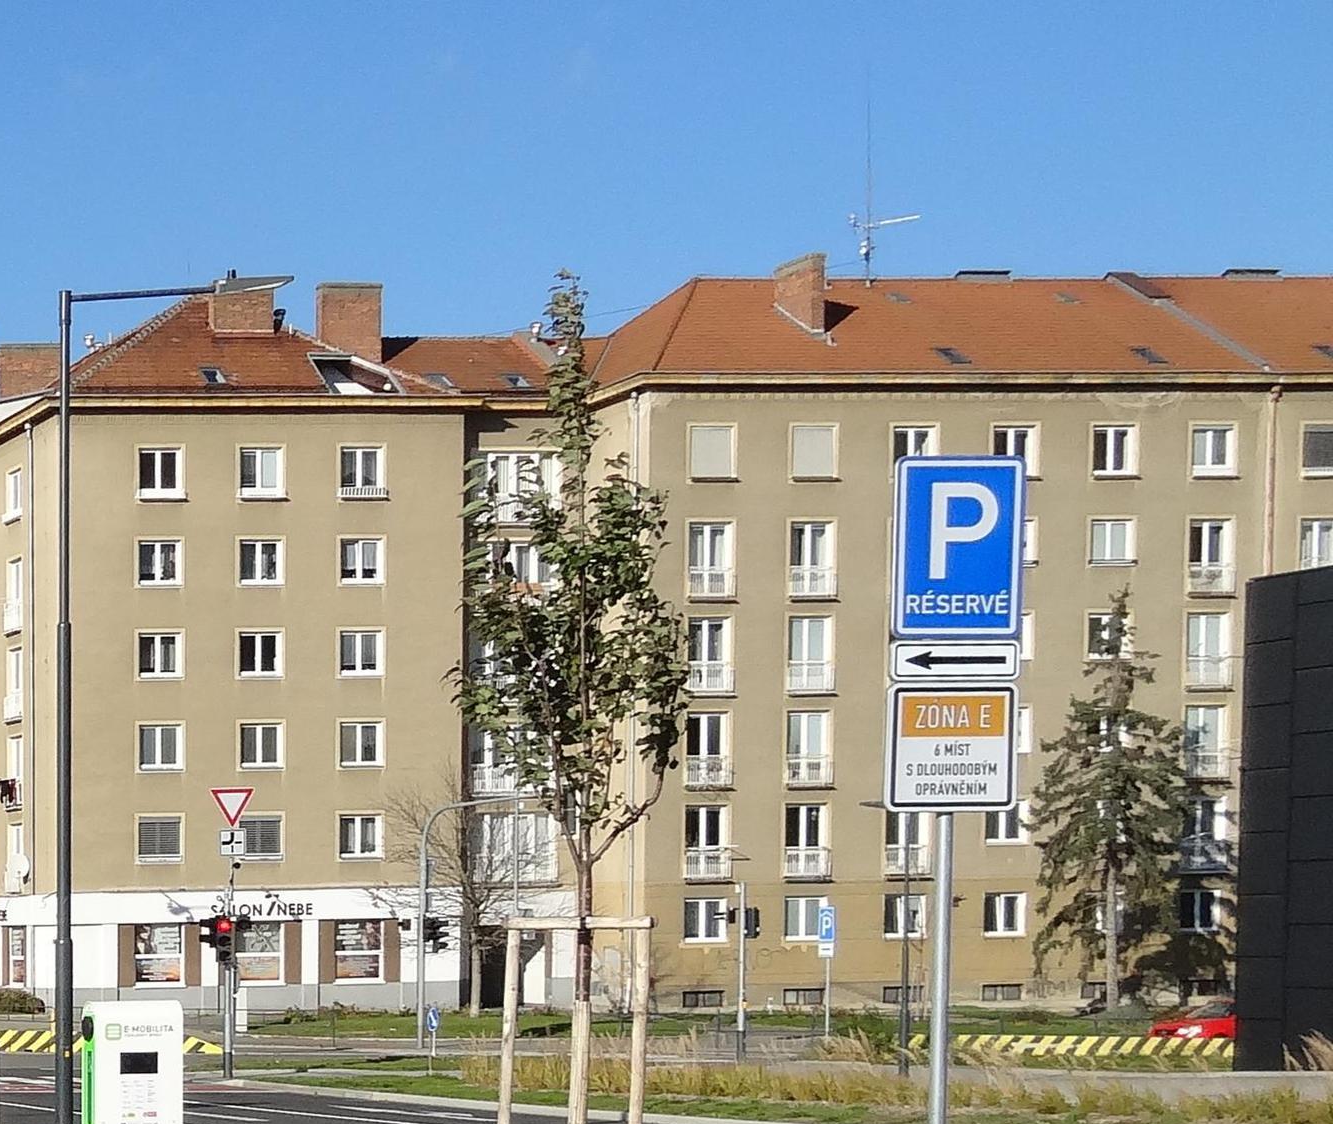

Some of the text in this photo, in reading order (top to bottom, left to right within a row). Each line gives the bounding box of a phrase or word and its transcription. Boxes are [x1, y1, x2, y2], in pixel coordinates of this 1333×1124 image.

[929, 482, 999, 579] P
[905, 590, 1009, 615] RÉSERVÉ
[915, 699, 992, 729] ZÓNA E
[934, 741, 971, 756] 6 MÍST
[906, 760, 997, 776] S DLOUHODOBÝM
[915, 780, 987, 796] OPRÁVNĚNÍM
[211, 904, 262, 916] SLON
[822, 916, 832, 936] P
